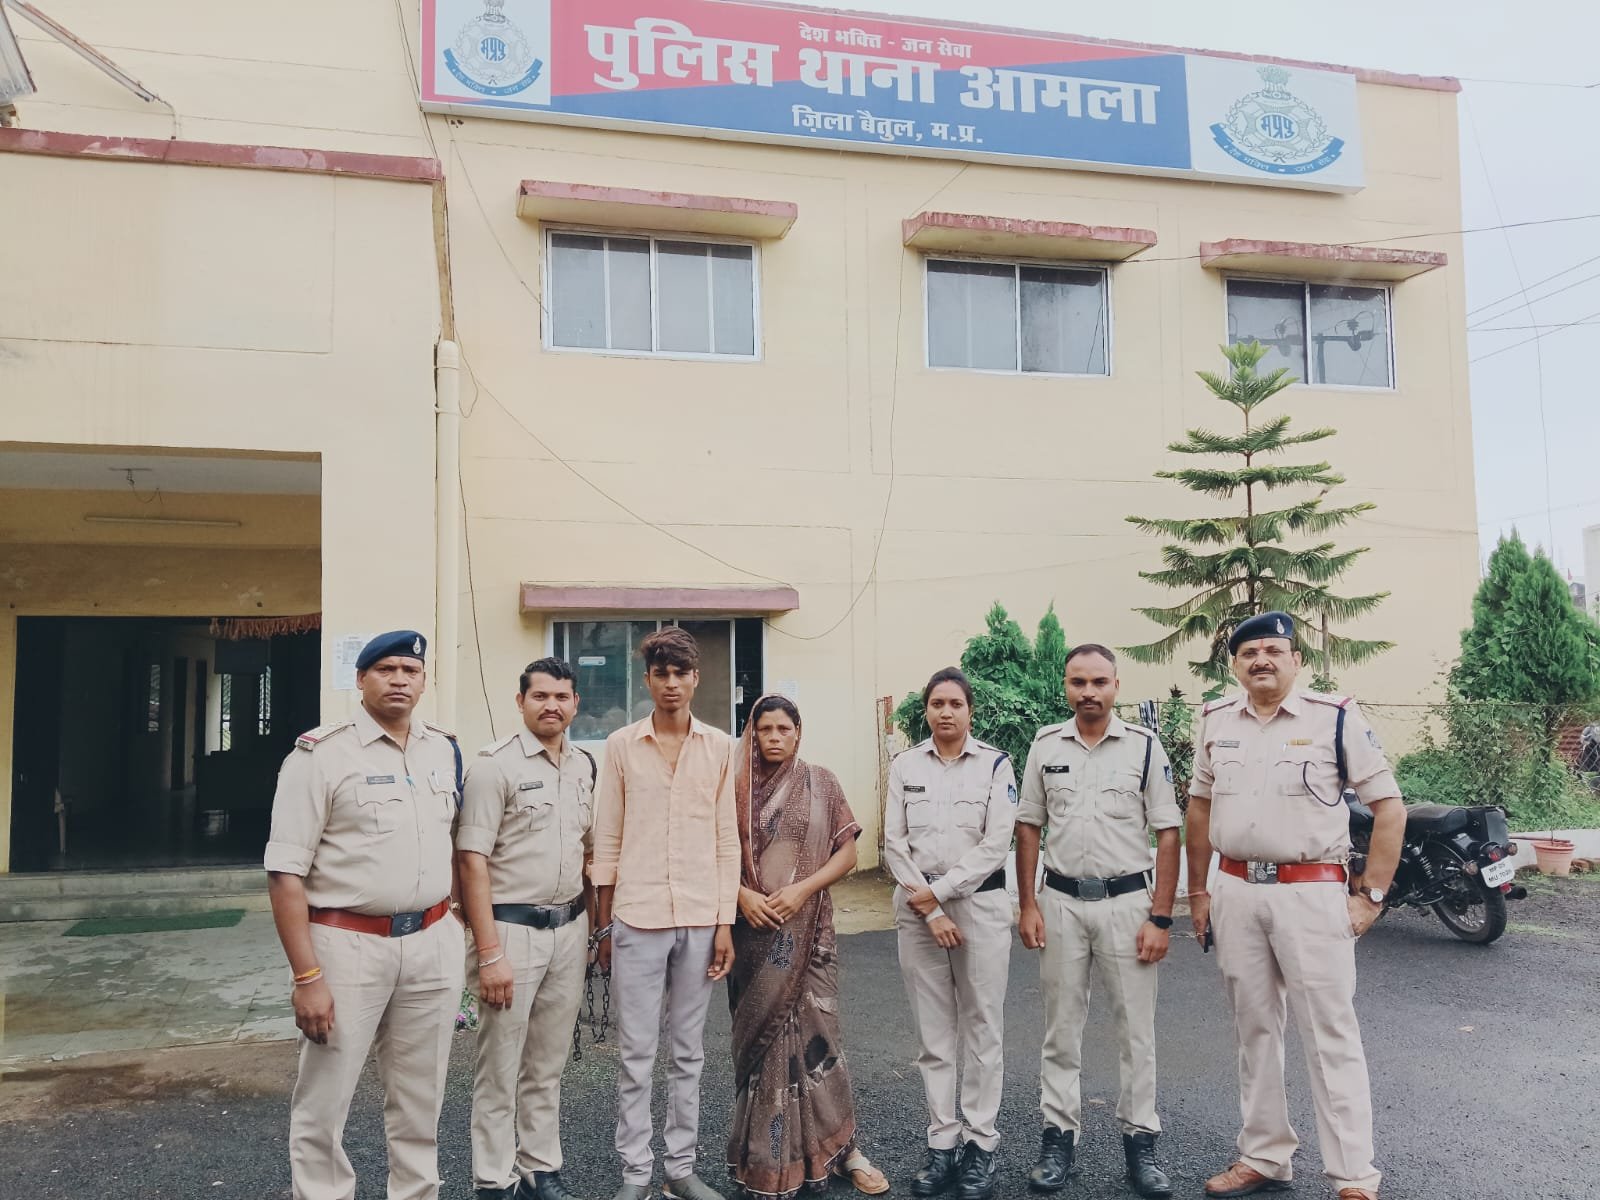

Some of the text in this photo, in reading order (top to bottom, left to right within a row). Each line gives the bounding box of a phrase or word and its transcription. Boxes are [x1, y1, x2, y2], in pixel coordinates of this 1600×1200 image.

[584, 17, 1160, 125] पुलिस थाना आमला
[799, 22, 829, 43] देश
[901, 38, 933, 54] जन
[937, 38, 972, 58] सेवा
